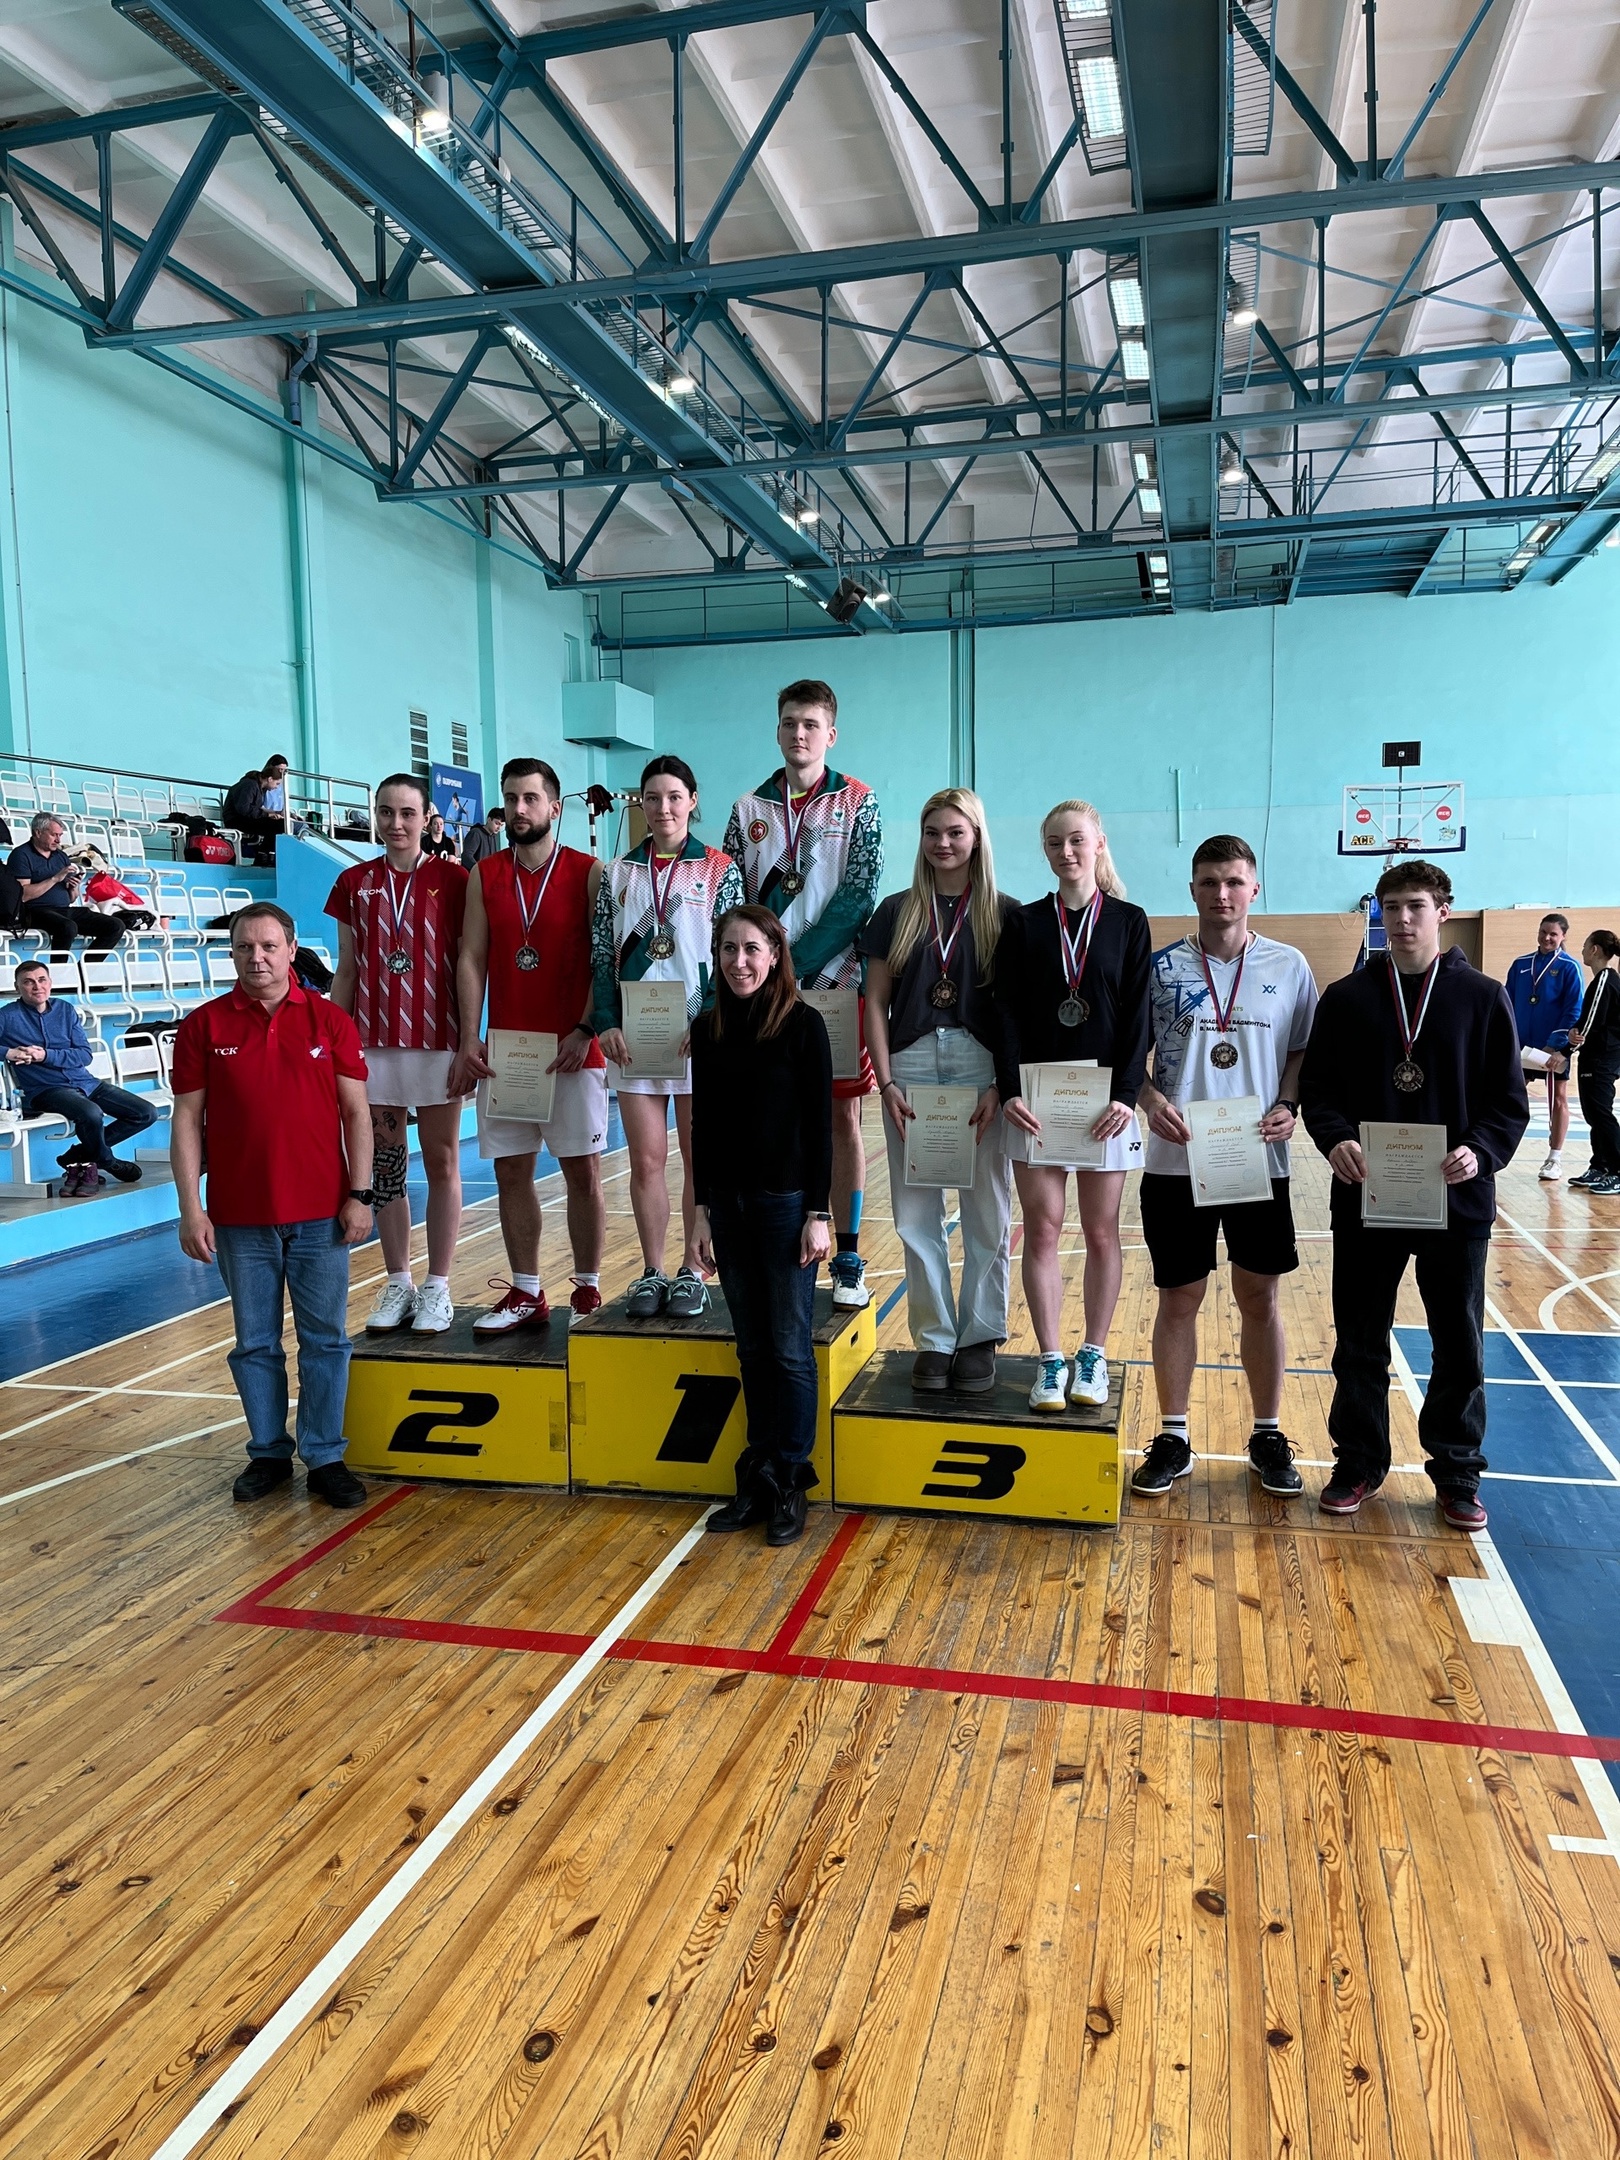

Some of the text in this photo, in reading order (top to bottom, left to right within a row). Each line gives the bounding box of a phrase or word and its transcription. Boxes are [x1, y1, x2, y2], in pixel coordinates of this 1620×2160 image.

[1053, 1088, 1089, 1096] ДИПЛОМ
[1385, 1143, 1423, 1151] ДИПЛОМ
[387, 1389, 500, 1457] 2
[655, 1373, 742, 1465] 1
[921, 1440, 1027, 1500] 3
